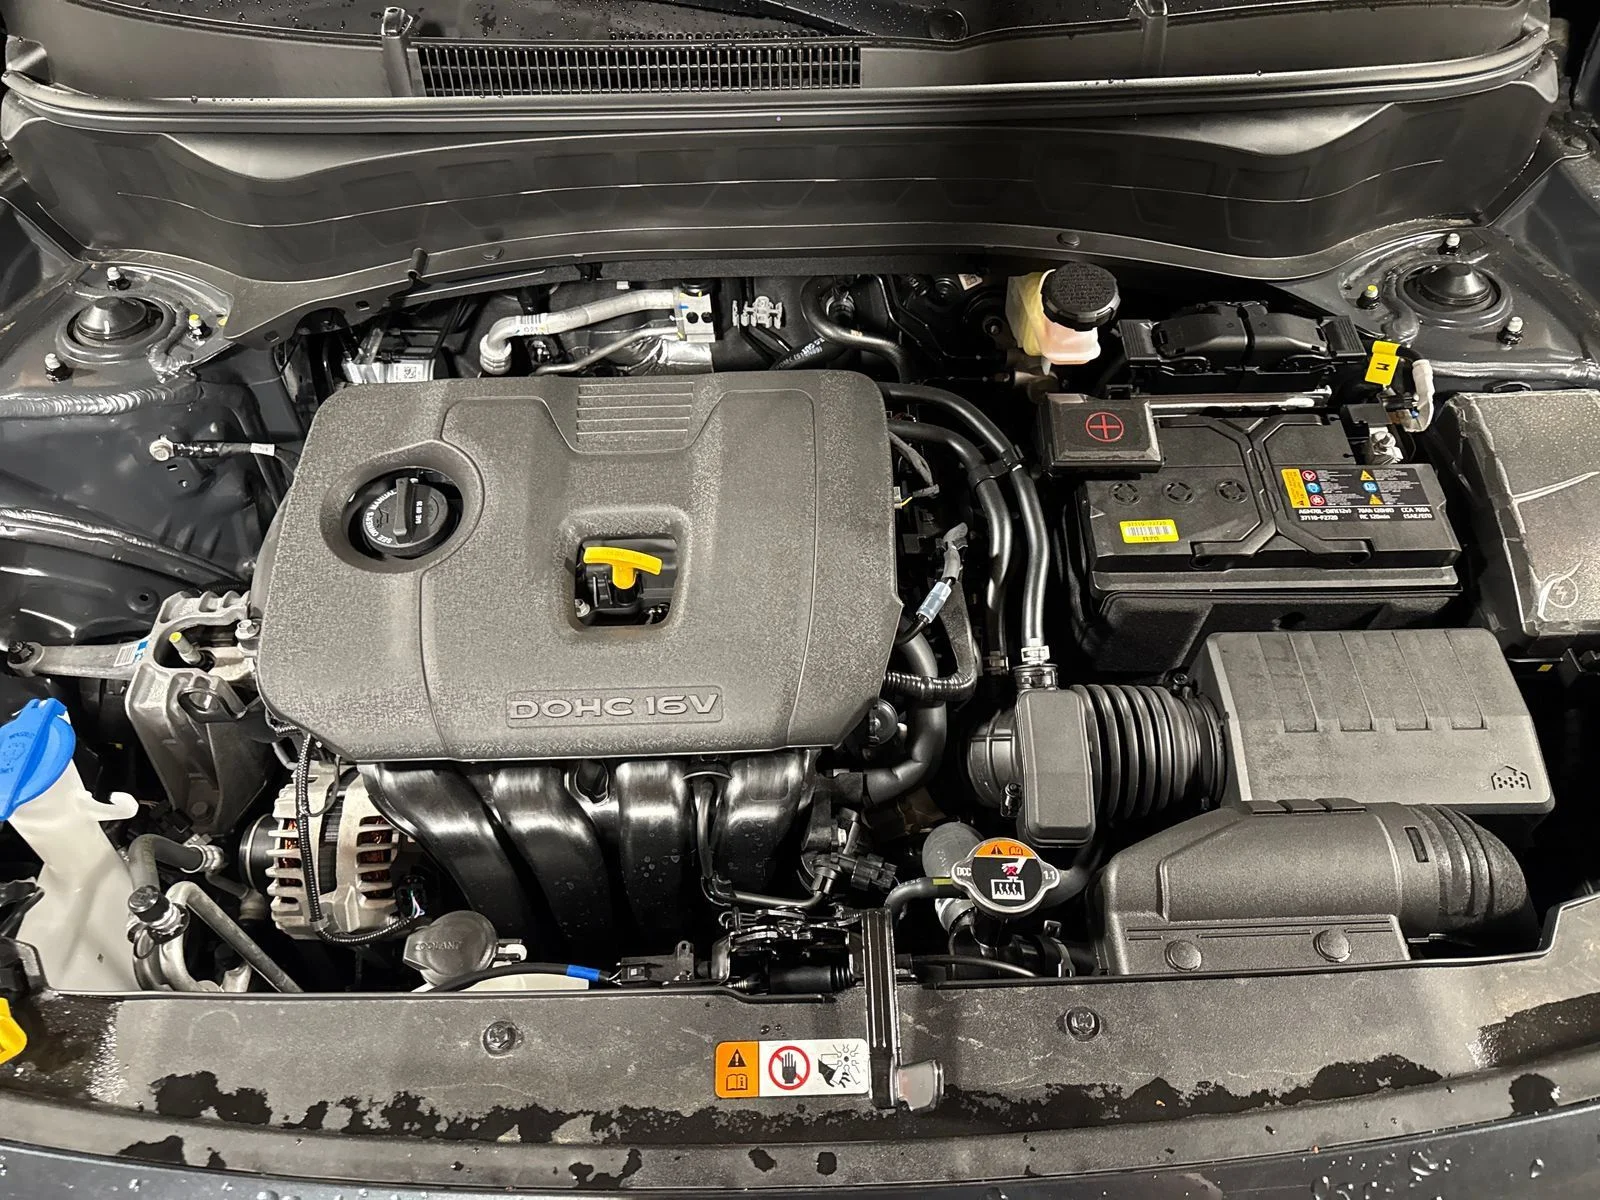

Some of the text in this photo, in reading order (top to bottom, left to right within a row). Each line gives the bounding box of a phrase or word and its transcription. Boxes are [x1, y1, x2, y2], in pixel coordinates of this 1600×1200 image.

[510, 693, 719, 720] DOHC 16V
[956, 866, 972, 877] DCC
[1043, 870, 1056, 880] 1.1
